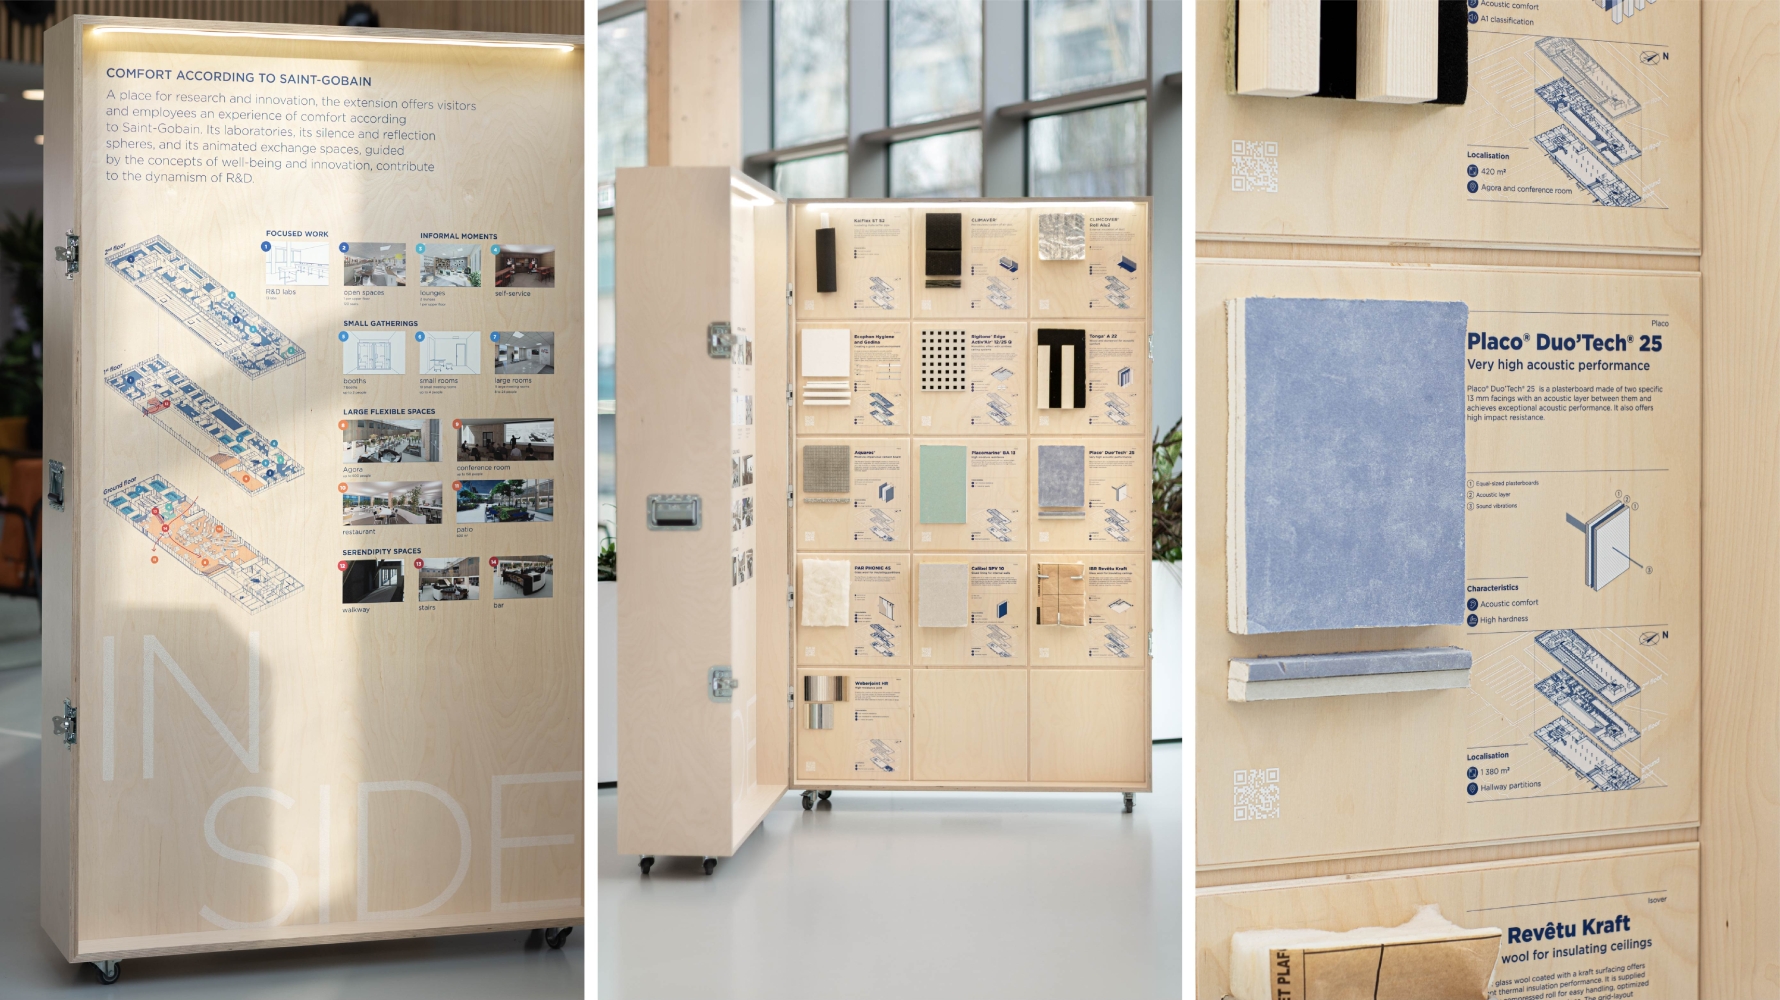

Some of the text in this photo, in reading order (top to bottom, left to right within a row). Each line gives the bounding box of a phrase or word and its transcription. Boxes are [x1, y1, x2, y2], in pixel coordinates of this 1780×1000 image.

[1512, 2, 1539, 10] comfort
[1490, 16, 1534, 25] classification
[106, 67, 371, 86] COMFORT ACCORDING TO SAINT-GOBAIN
[106, 89, 476, 110] A place for research and innovation, the extension offers visitors
[105, 106, 406, 126] and employees an experience of comfort according
[106, 122, 435, 140] to Saint-Gobain. Its laboratories, its silence and reflection
[106, 139, 404, 156] spheres, and its animated exchange spaces, guided
[1467, 151, 1509, 159] Localisation
[1481, 167, 1495, 175] 420
[1481, 183, 1501, 191] Agora
[1651, 319, 1669, 327] Placo
[1467, 332, 1662, 352] Placo® Duo'Tech® 25
[1467, 358, 1650, 371] Very high acoustic performance
[494, 377, 531, 386] large rooms
[1638, 385, 1663, 393] specific
[103, 476, 137, 495] Ground floor
[1466, 584, 1518, 592] Characteristics
[1511, 598, 1538, 606] comfort
[1480, 616, 1496, 624] High
[1662, 631, 1669, 639] N
[102, 632, 259, 781] IN
[1466, 752, 1509, 760] Localisation
[1485, 767, 1499, 775] 380
[1500, 766, 1510, 774] m²
[1508, 781, 1541, 789] partitions
[199, 771, 583, 930] SIDE
[1507, 914, 1630, 943] Revêtu Kraft
[1501, 938, 1652, 963] wool for insulating ceilings
[1274, 949, 1284, 973] PLAF
[1495, 979, 1512, 987] glass
[1531, 973, 1555, 982] coated
[1578, 968, 1593, 976] kraft
[1595, 965, 1625, 974] surfacing
[1626, 963, 1645, 973] offers
